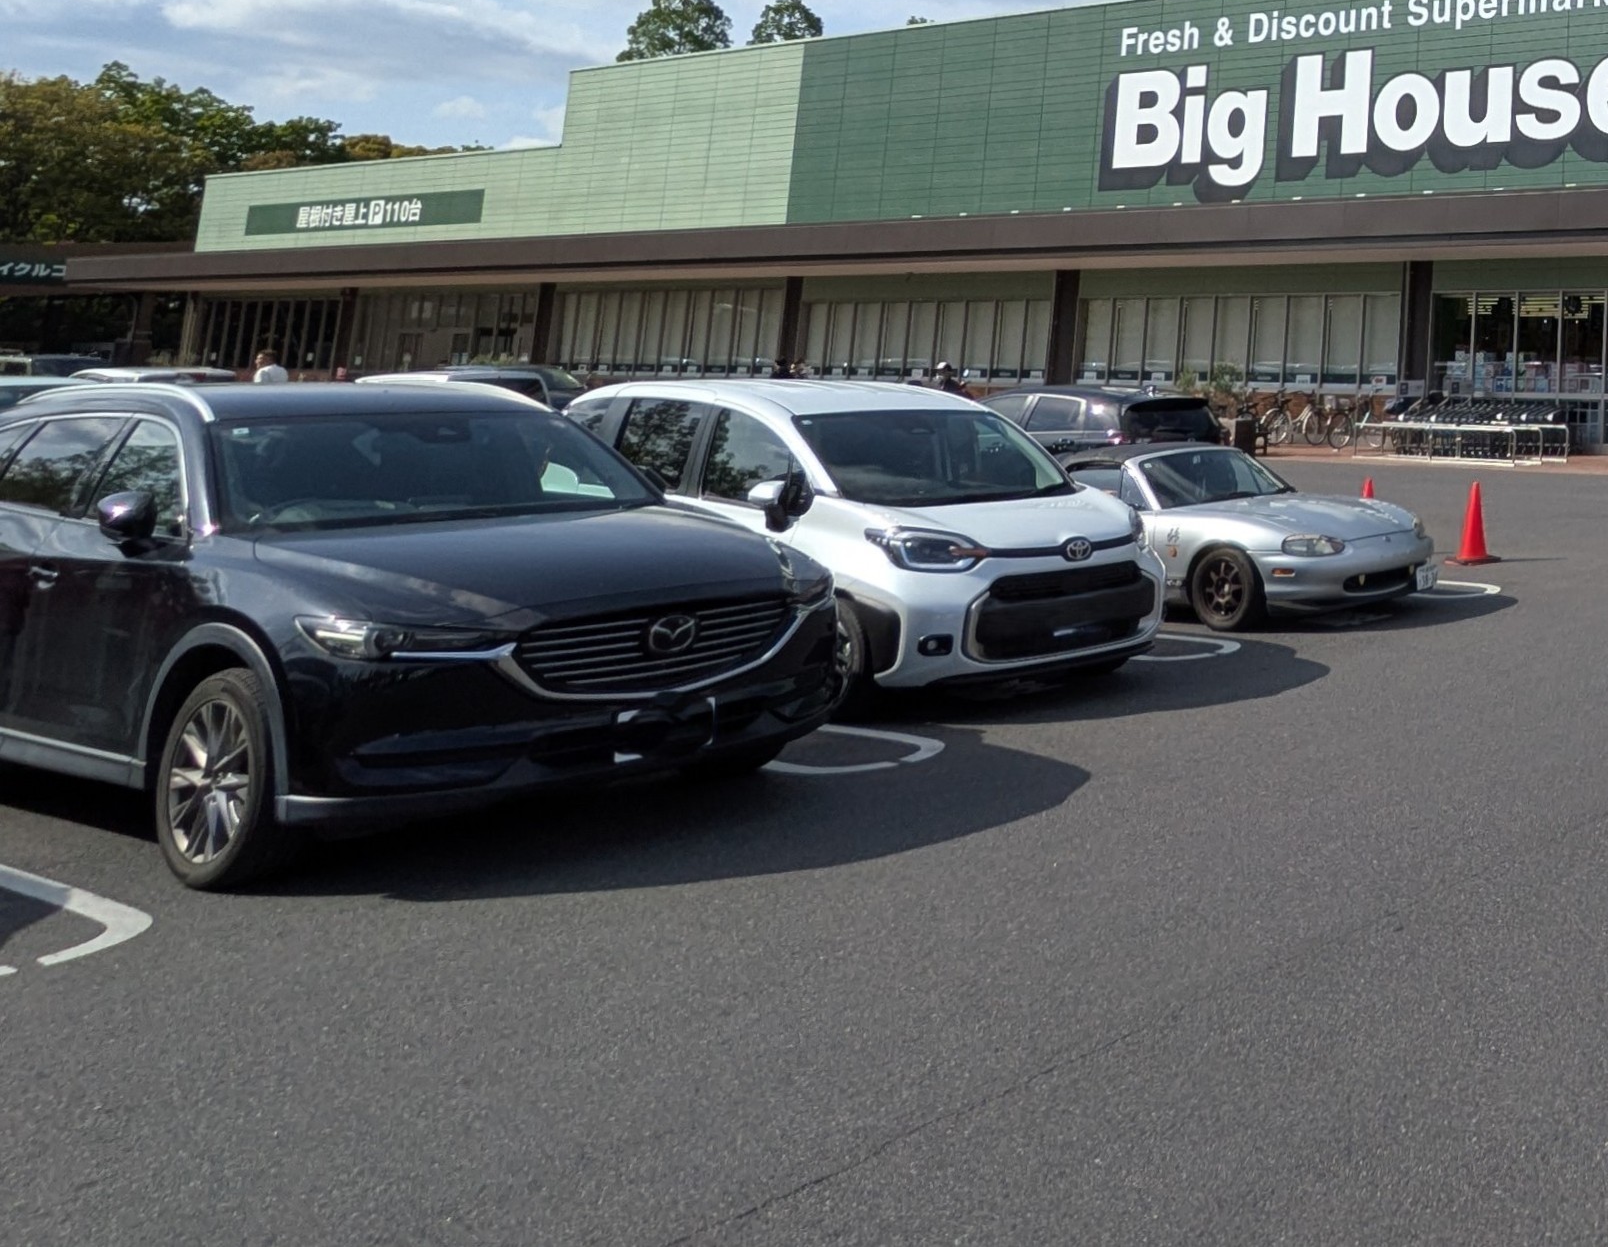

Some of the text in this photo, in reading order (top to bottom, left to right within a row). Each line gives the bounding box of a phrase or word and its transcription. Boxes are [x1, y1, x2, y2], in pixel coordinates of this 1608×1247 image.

[1120, 20, 1200, 57] Fresh
[1213, 16, 1234, 47] &
[1248, 0, 1393, 43] Discount
[1111, 65, 1269, 187] Big
